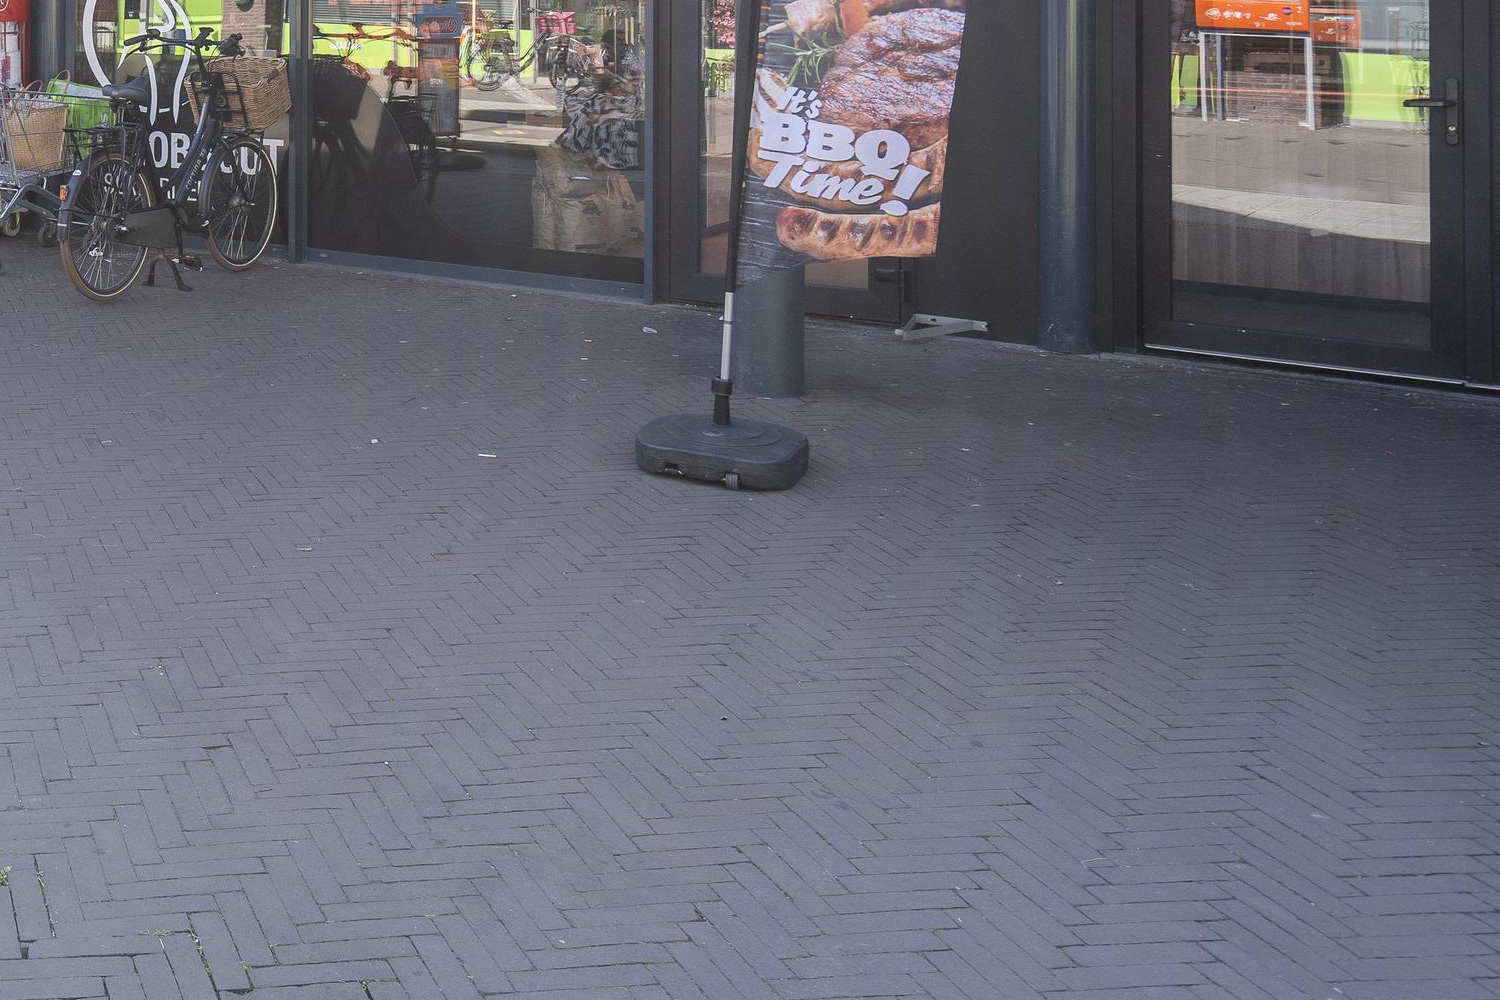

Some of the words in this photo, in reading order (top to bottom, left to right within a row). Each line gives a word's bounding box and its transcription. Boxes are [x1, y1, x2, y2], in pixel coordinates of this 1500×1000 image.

[776, 86, 823, 119] It's
[759, 111, 911, 181] BBQ
[757, 149, 931, 217] Time!
